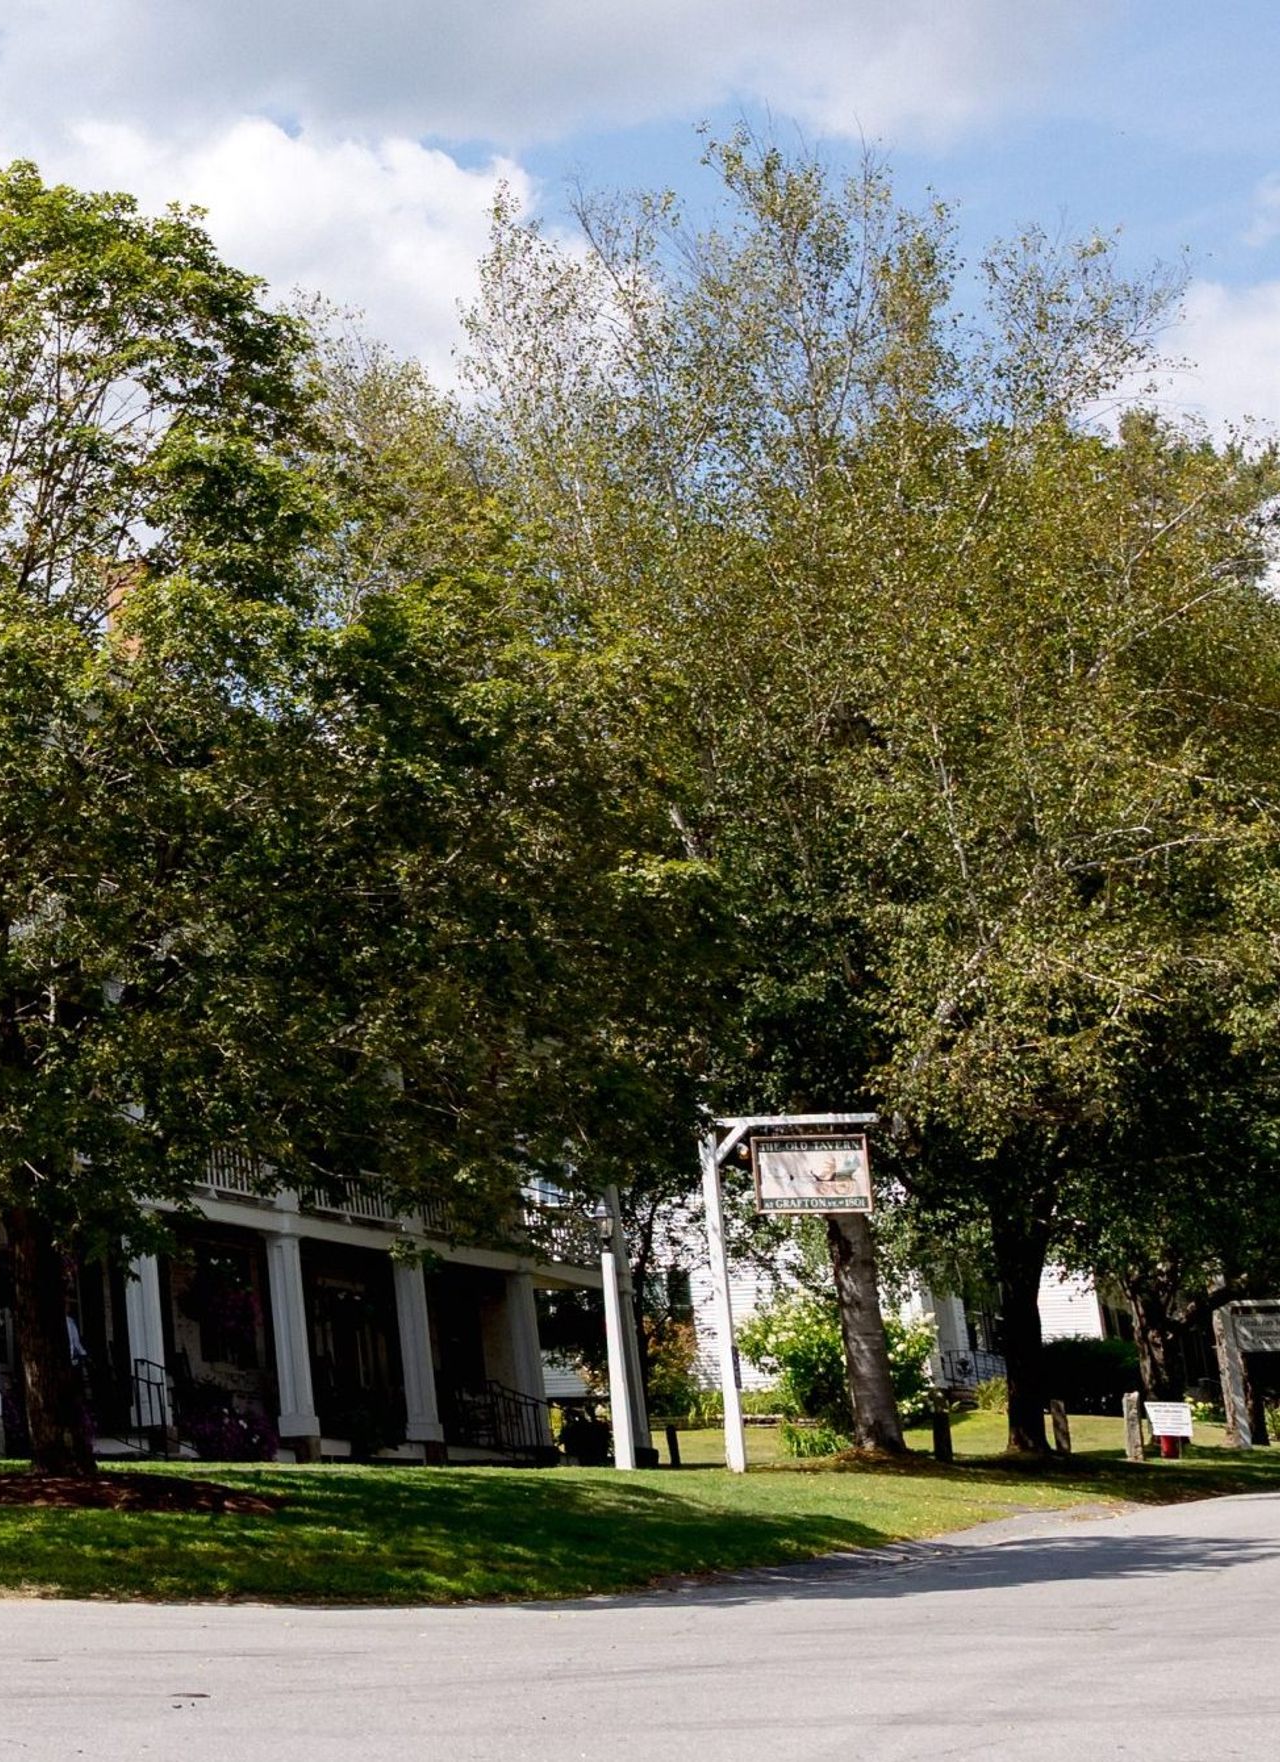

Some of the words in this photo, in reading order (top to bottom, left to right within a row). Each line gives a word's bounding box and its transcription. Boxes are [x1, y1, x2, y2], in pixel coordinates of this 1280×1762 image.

[760, 1142, 780, 1152] THE
[785, 1142, 808, 1151] OLD
[814, 1140, 860, 1150] TAVERN
